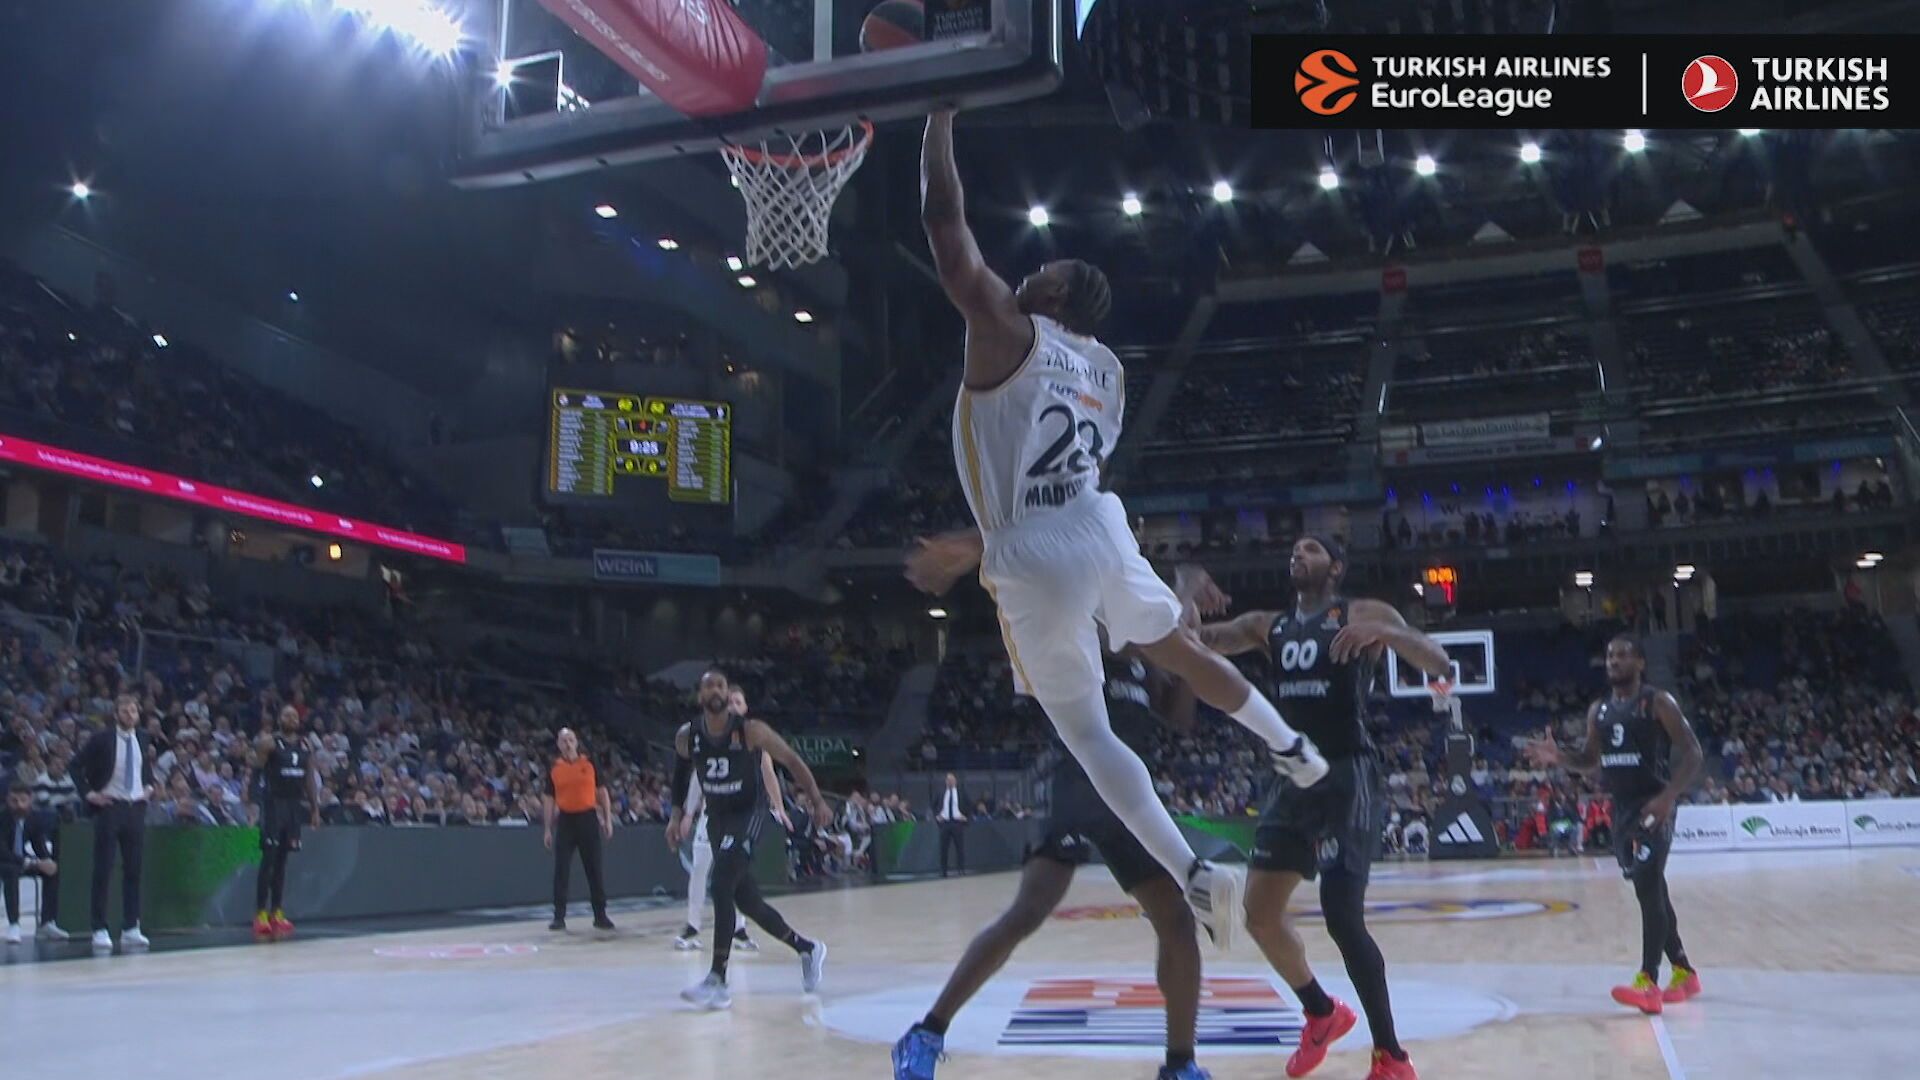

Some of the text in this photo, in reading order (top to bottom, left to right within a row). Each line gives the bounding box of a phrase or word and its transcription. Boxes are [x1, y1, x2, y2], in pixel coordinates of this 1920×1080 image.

[1281, 638, 1319, 671] 00
[791, 736, 848, 753] ALIDA
[706, 757, 730, 779] 23
